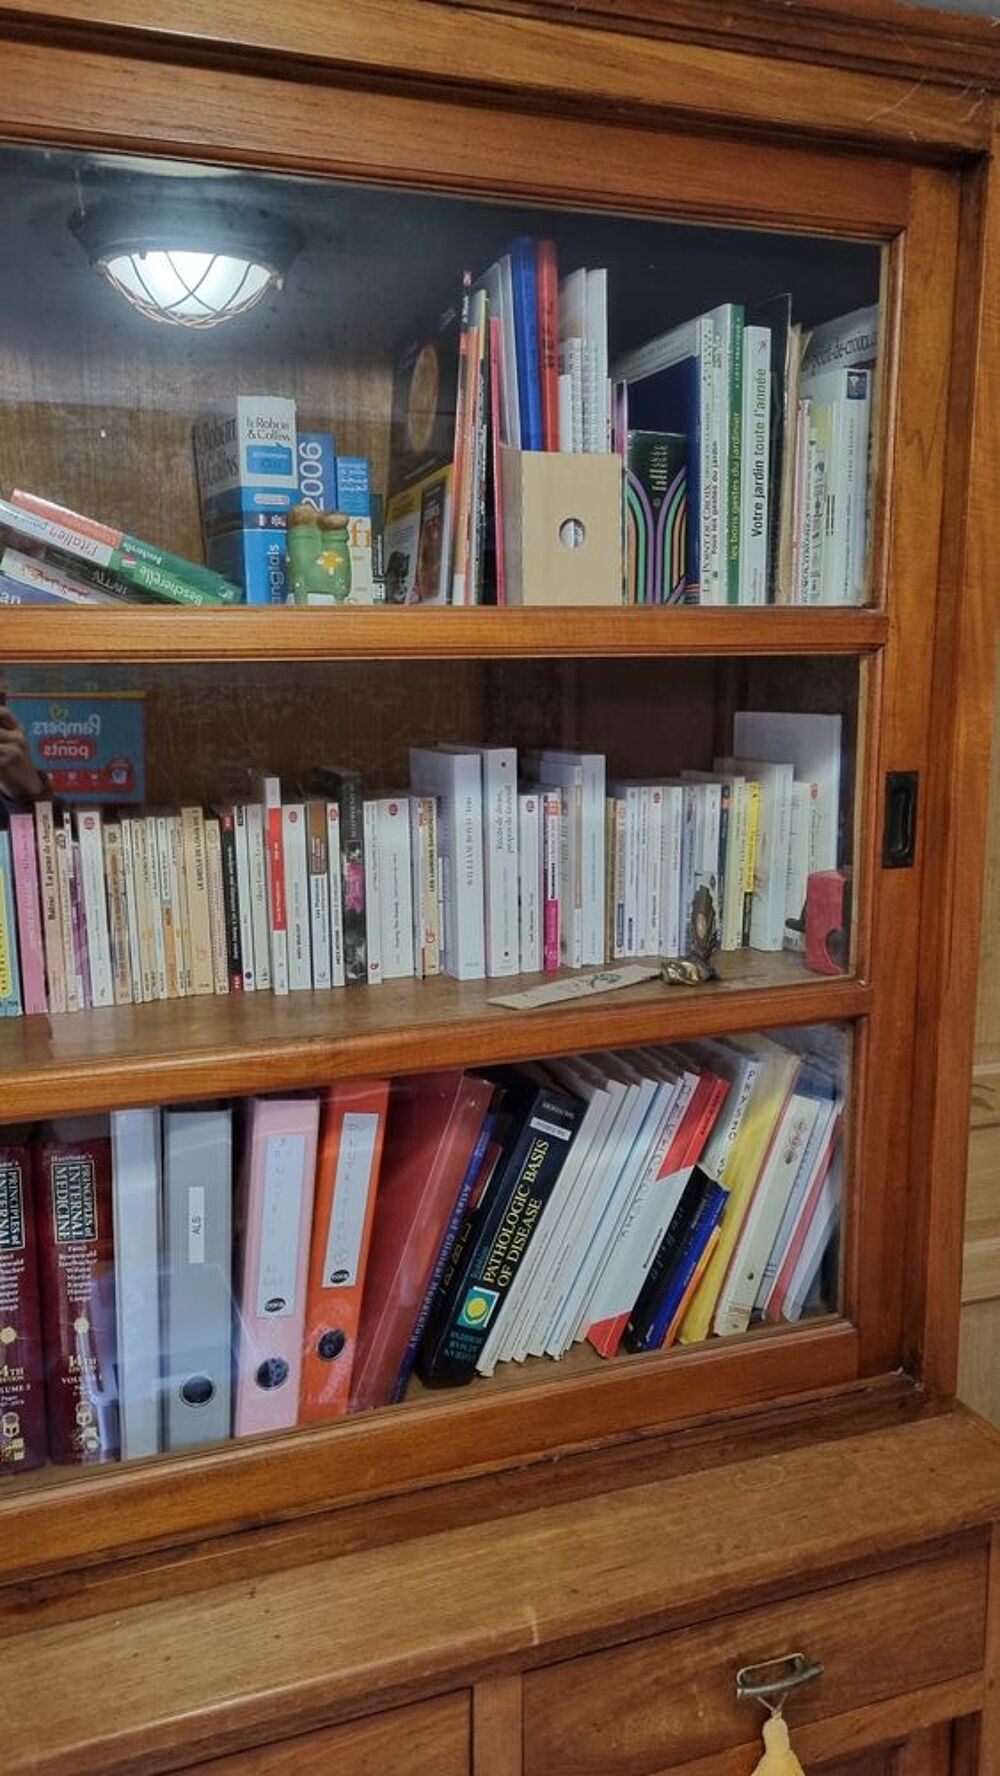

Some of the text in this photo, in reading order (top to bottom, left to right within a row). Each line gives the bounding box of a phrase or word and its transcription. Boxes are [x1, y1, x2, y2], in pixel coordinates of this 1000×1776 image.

[731, 411, 741, 461] jardinier
[731, 461, 740, 477] du
[750, 368, 767, 538] Votre jardin toute l'année
[299, 441, 325, 512] 2006
[730, 479, 741, 514] gestes
[730, 516, 739, 543] bons
[55, 1166, 70, 1240] MEDICINE
[69, 1166, 83, 1239] INTERNAL
[191, 1216, 202, 1236] ALS
[482, 1138, 550, 1285] PATHOLOGIC BASIS
[497, 1198, 543, 1288] OF DISEASE
